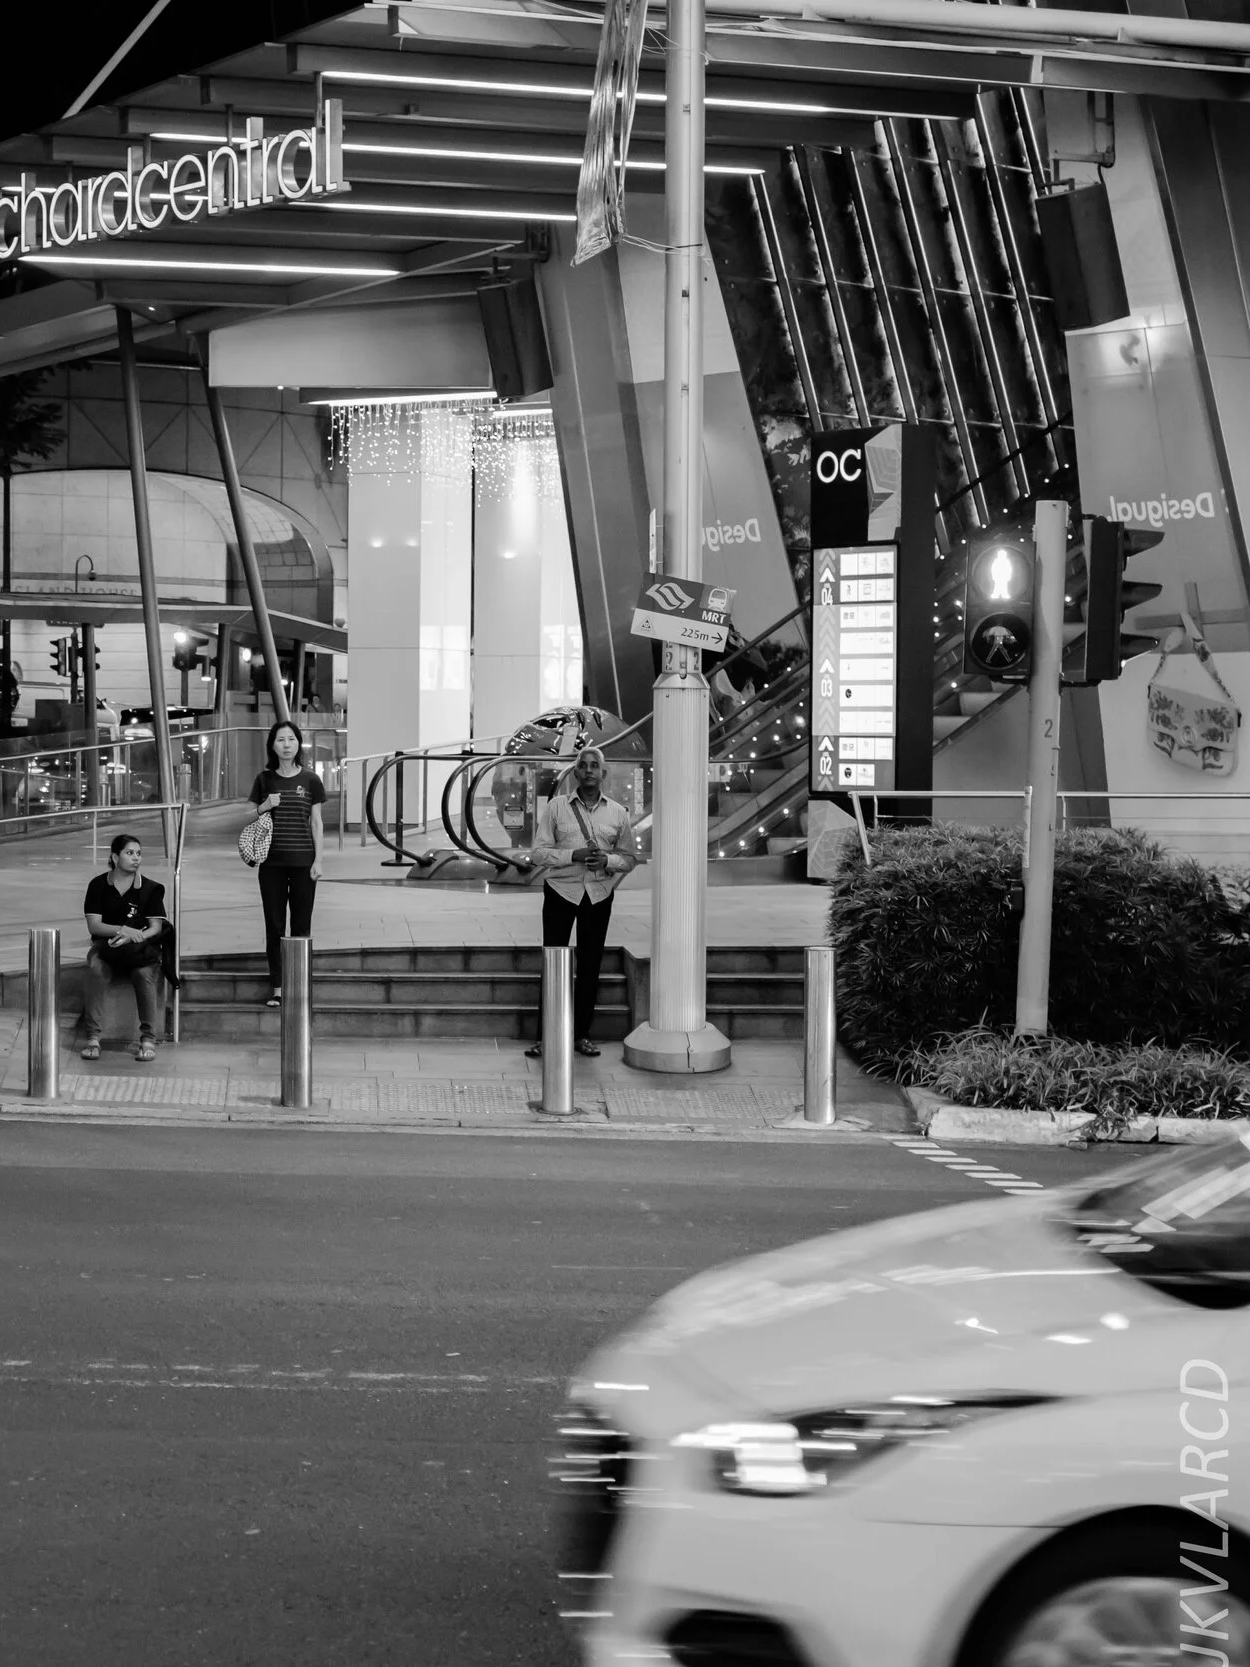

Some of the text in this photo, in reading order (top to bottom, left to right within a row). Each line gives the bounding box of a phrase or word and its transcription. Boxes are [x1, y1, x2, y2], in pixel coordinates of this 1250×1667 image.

[816, 448, 862, 484] OC
[821, 587, 833, 606] 04
[702, 610, 727, 625] MRT
[681, 627, 710, 642] 225m
[821, 679, 833, 697] 03
[1044, 719, 1054, 738] 2
[819, 756, 832, 775] 02
